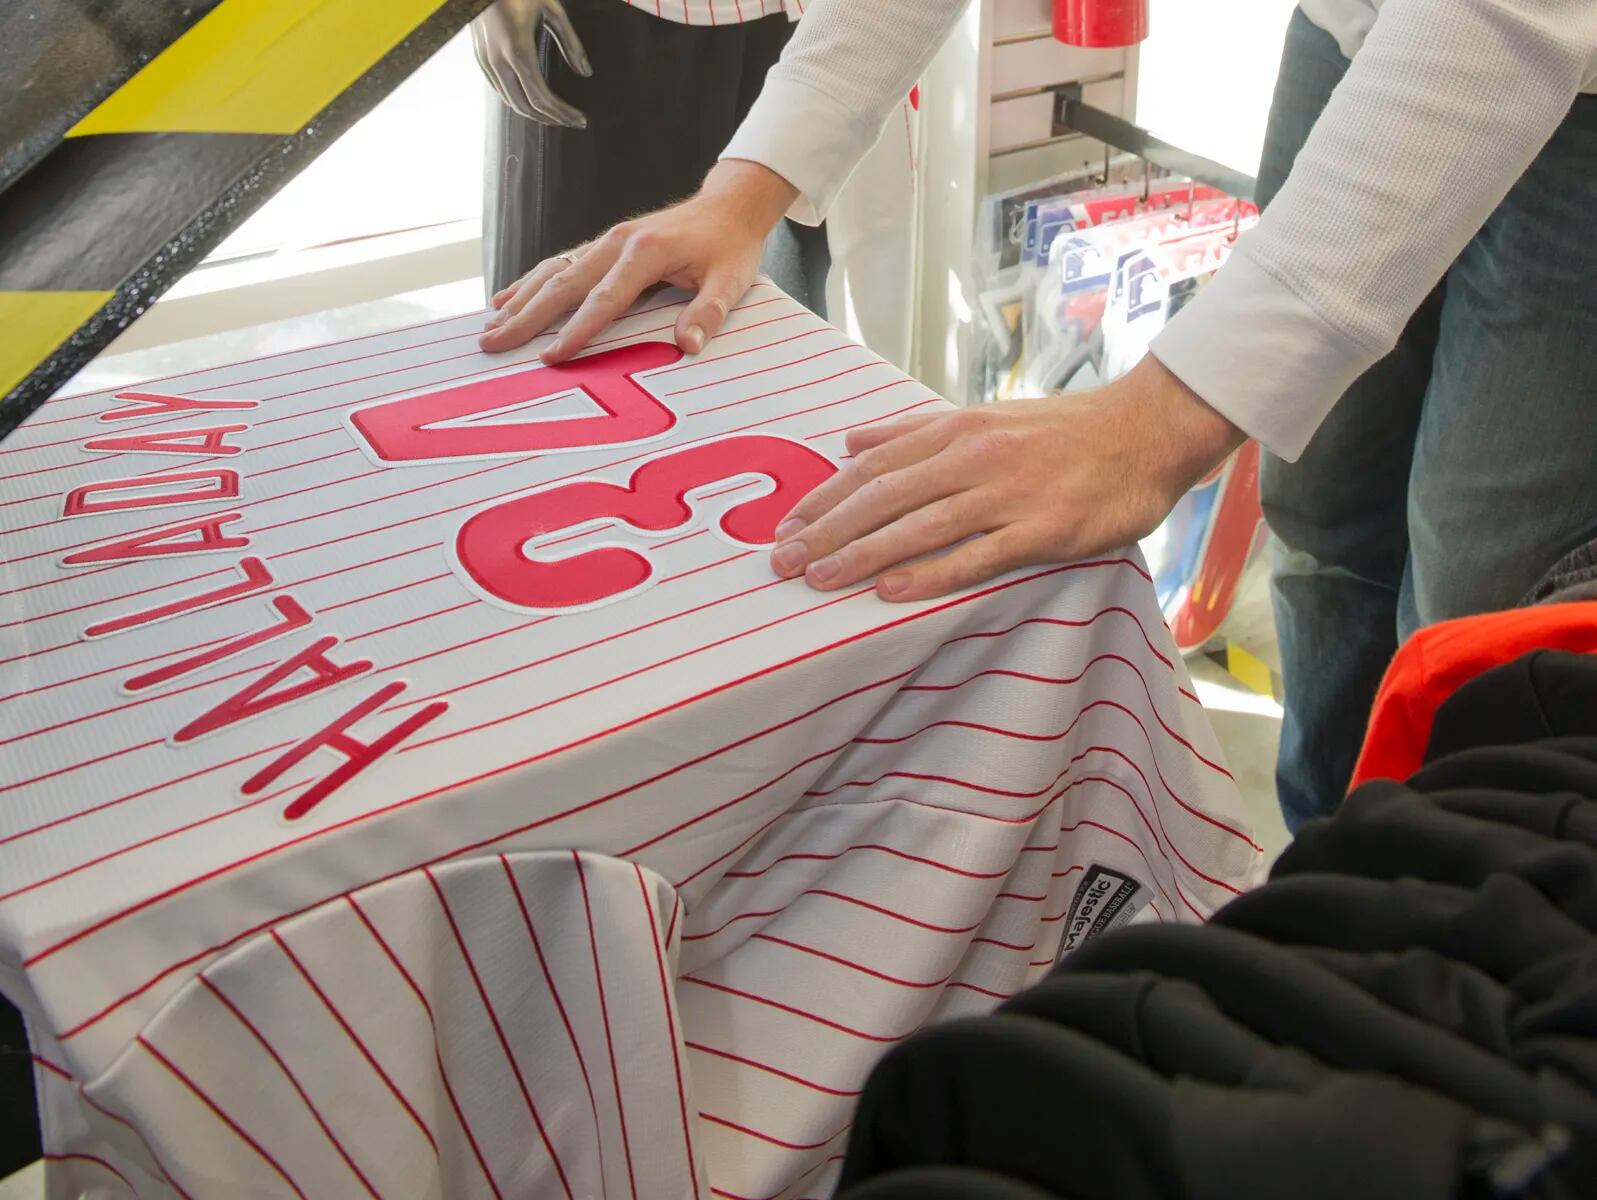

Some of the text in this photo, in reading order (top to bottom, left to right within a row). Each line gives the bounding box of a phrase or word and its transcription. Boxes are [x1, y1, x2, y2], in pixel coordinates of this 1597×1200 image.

[349, 340, 840, 610] 34
[60, 390, 450, 822] HALLADAY
[1063, 879, 1112, 952] Majestic
[1105, 880, 1136, 919] BASEBALL
